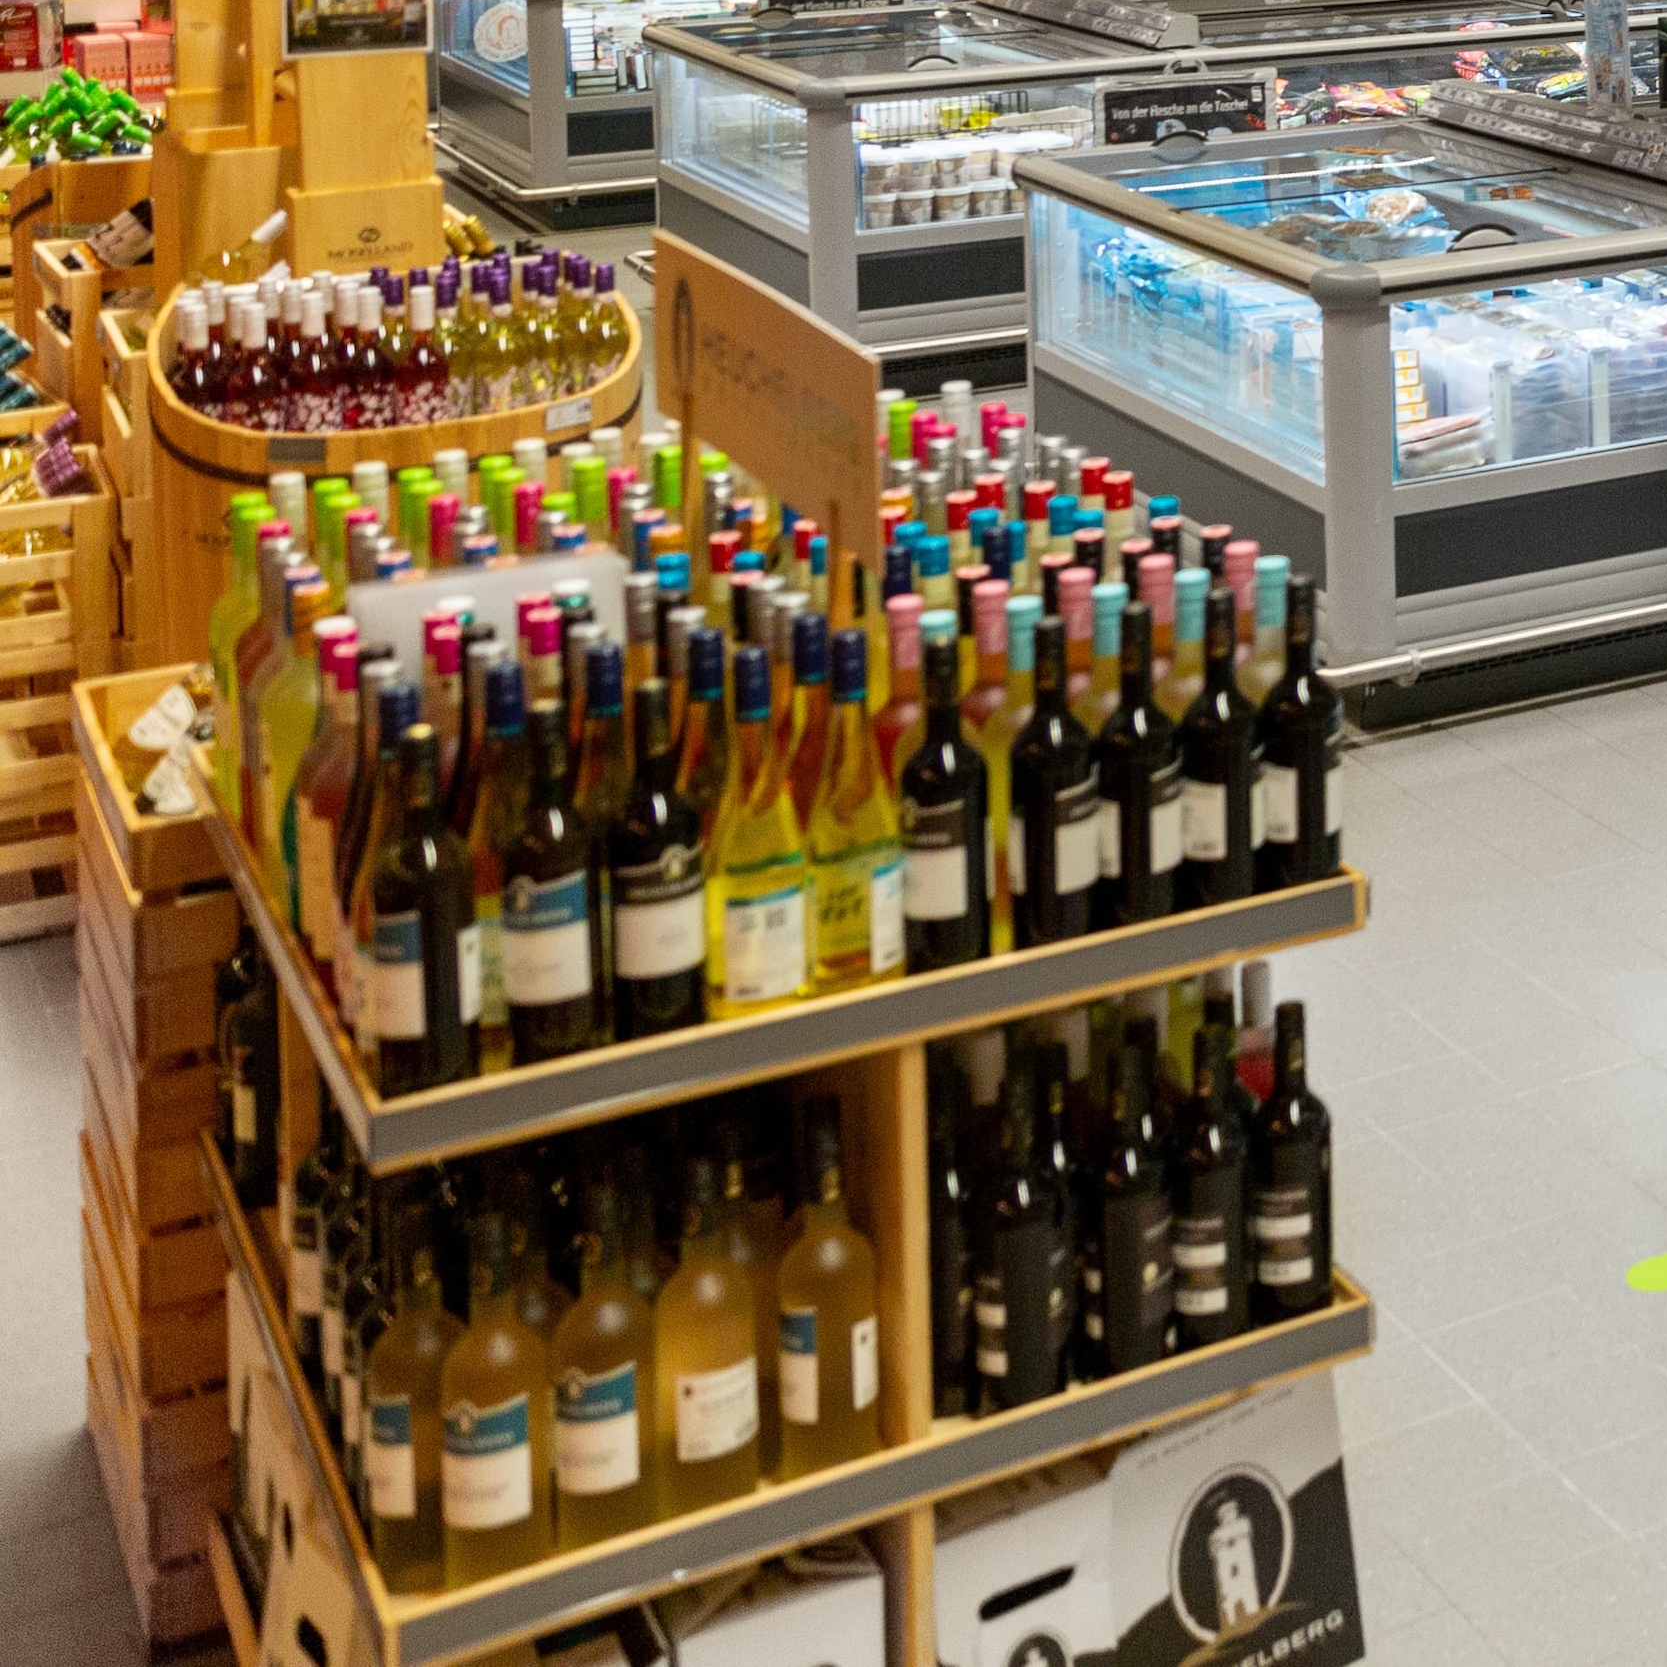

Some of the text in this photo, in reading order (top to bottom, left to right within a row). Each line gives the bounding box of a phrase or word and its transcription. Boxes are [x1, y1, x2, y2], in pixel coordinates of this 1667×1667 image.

[1112, 107, 1130, 120] Von
[1131, 105, 1149, 119] der
[1186, 104, 1198, 114] an
[1199, 101, 1213, 114] die
[1215, 98, 1248, 113] Tasche!
